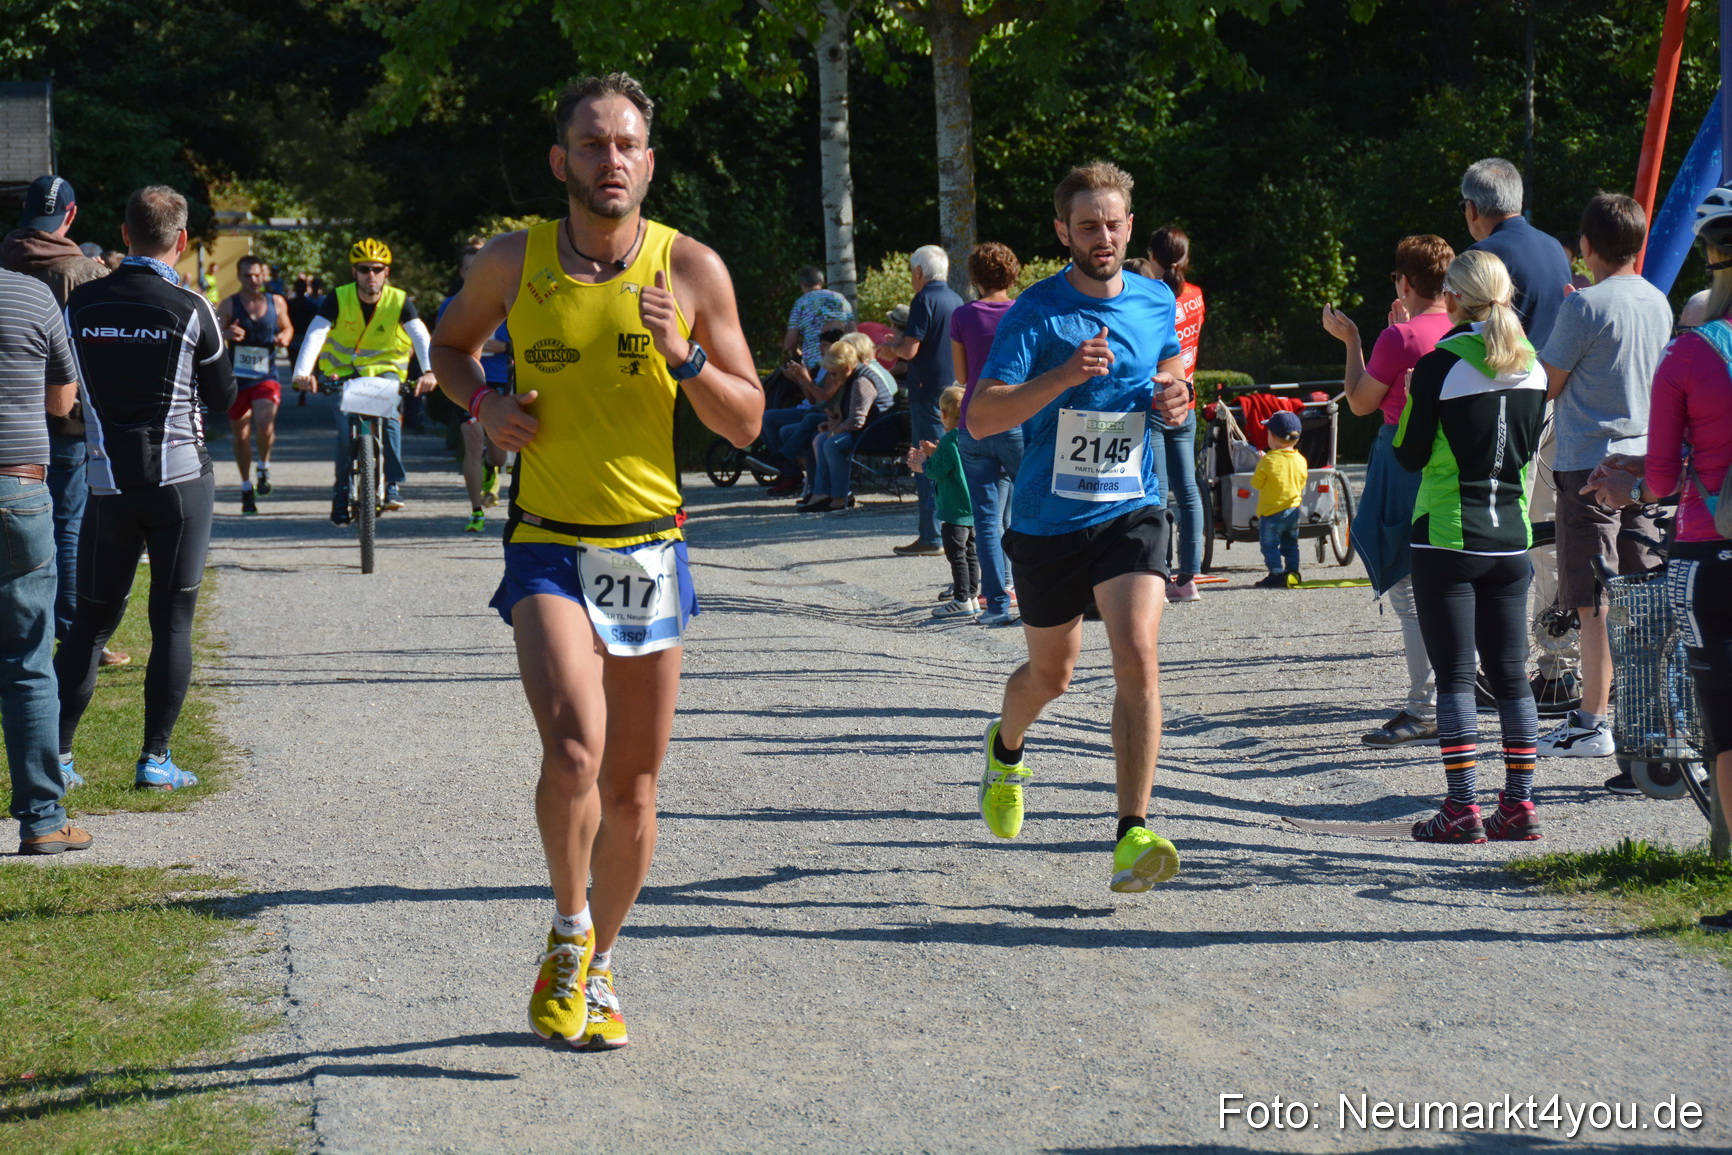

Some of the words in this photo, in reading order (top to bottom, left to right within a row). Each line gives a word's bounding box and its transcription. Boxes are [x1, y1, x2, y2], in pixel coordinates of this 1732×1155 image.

[618, 333, 650, 352] MTP
[1087, 420, 1125, 430] BOCK
[1070, 435, 1131, 463] 2145
[1078, 479, 1119, 491] Andreas
